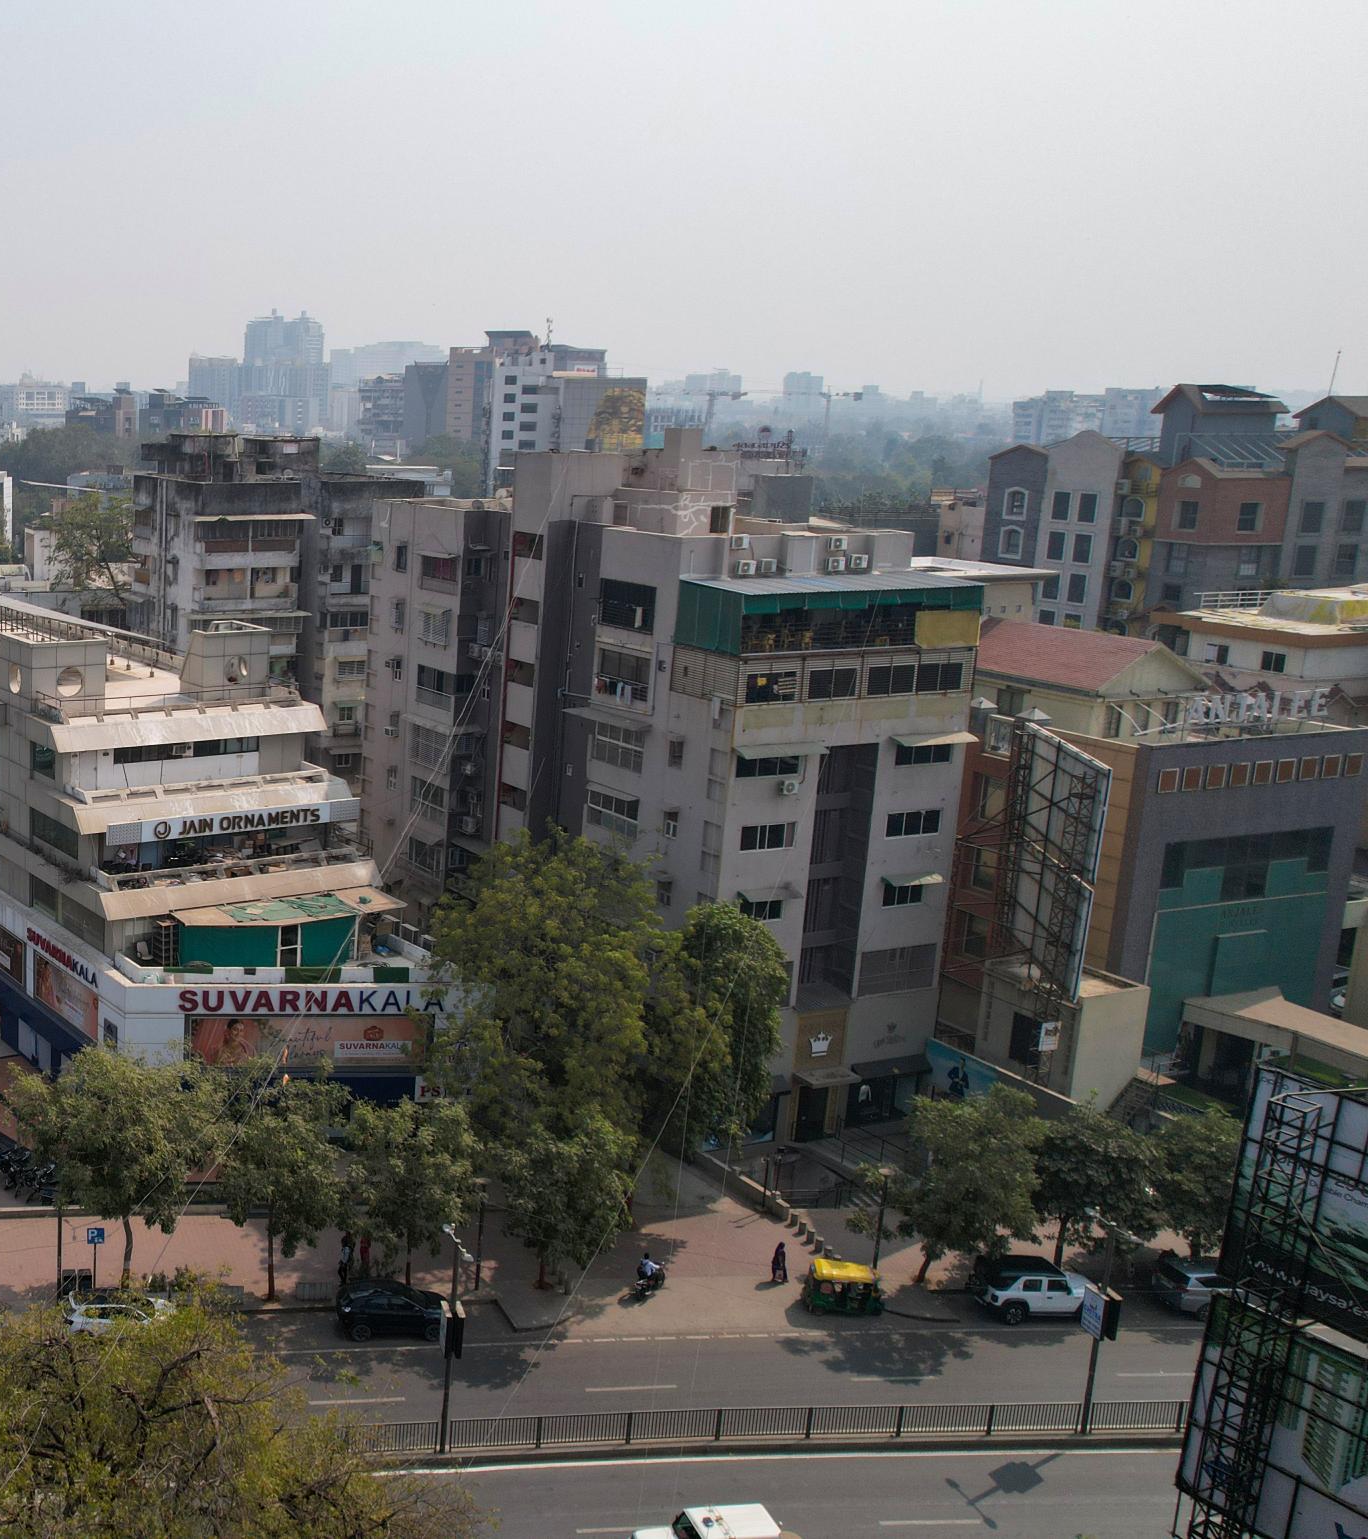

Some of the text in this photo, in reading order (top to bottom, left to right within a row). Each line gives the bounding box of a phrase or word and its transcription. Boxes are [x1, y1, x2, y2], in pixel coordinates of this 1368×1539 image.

[178, 816, 215, 838] JAIN
[218, 806, 321, 831] ORNAMENTS
[26, 926, 99, 989] SUVARNAKALA
[178, 989, 445, 1015] SUVARNAKALA
[338, 1042, 401, 1051] SUVARNAKAL
[88, 1229, 97, 1241] P
